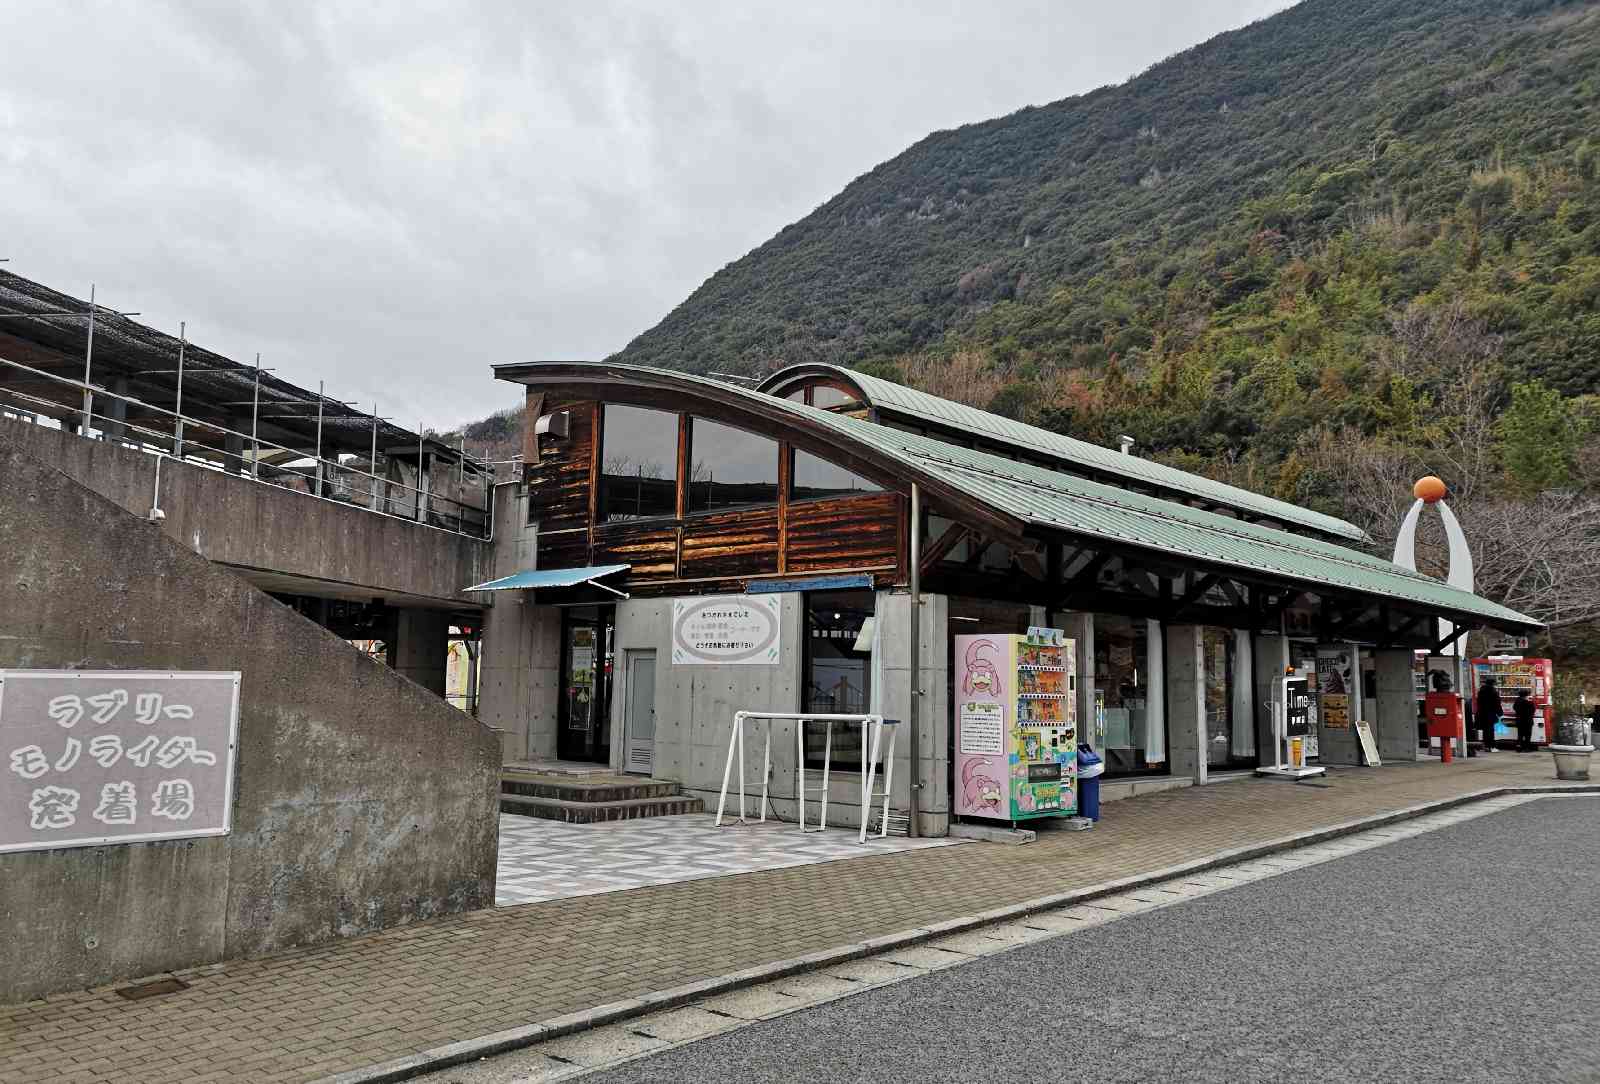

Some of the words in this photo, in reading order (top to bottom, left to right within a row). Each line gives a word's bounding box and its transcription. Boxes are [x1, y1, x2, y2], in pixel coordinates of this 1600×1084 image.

[48, 689, 193, 728] ラブリー
[10, 735, 216, 779] モノライダー
[29, 779, 194, 829] 発着場
